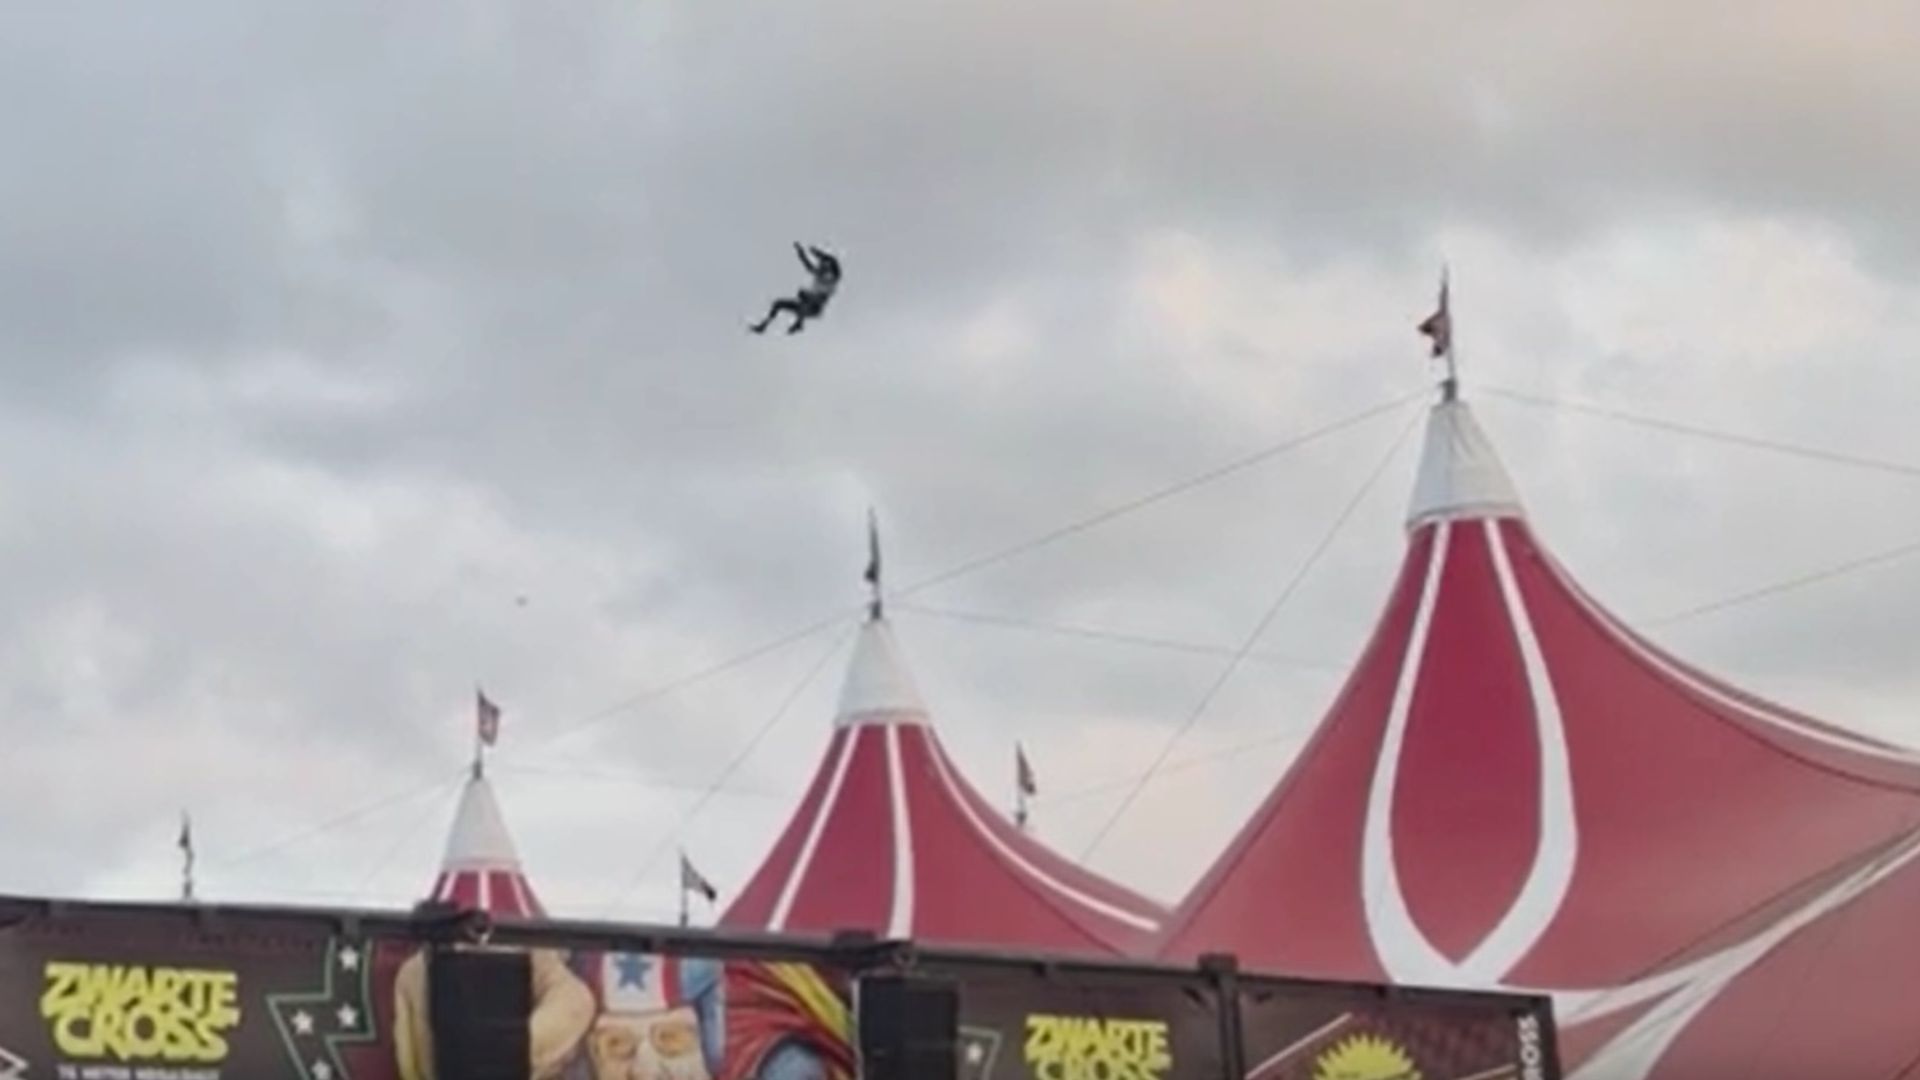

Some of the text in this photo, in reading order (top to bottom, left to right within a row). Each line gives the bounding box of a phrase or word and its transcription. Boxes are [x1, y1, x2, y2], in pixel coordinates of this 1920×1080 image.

[41, 962, 240, 1026] ZWARTE
[55, 1005, 228, 1061] CROSS
[1024, 1013, 1172, 1070] ZWARTE
